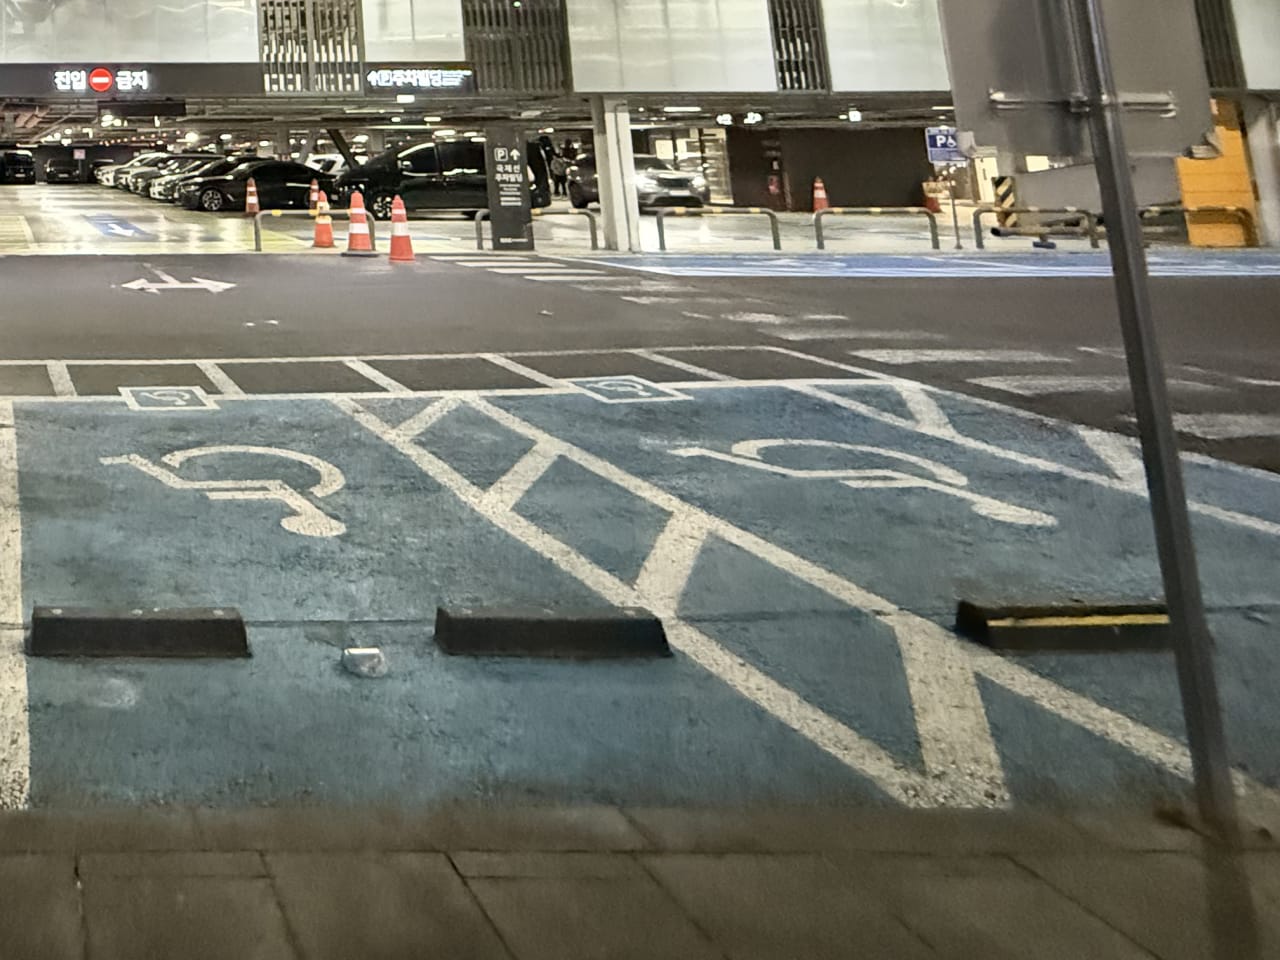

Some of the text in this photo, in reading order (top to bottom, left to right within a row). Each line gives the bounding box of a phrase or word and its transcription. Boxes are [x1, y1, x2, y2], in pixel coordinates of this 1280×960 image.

[54, 70, 148, 90] 진입 금지
[392, 69, 442, 86] 주차빌딩
[935, 135, 947, 147] P
